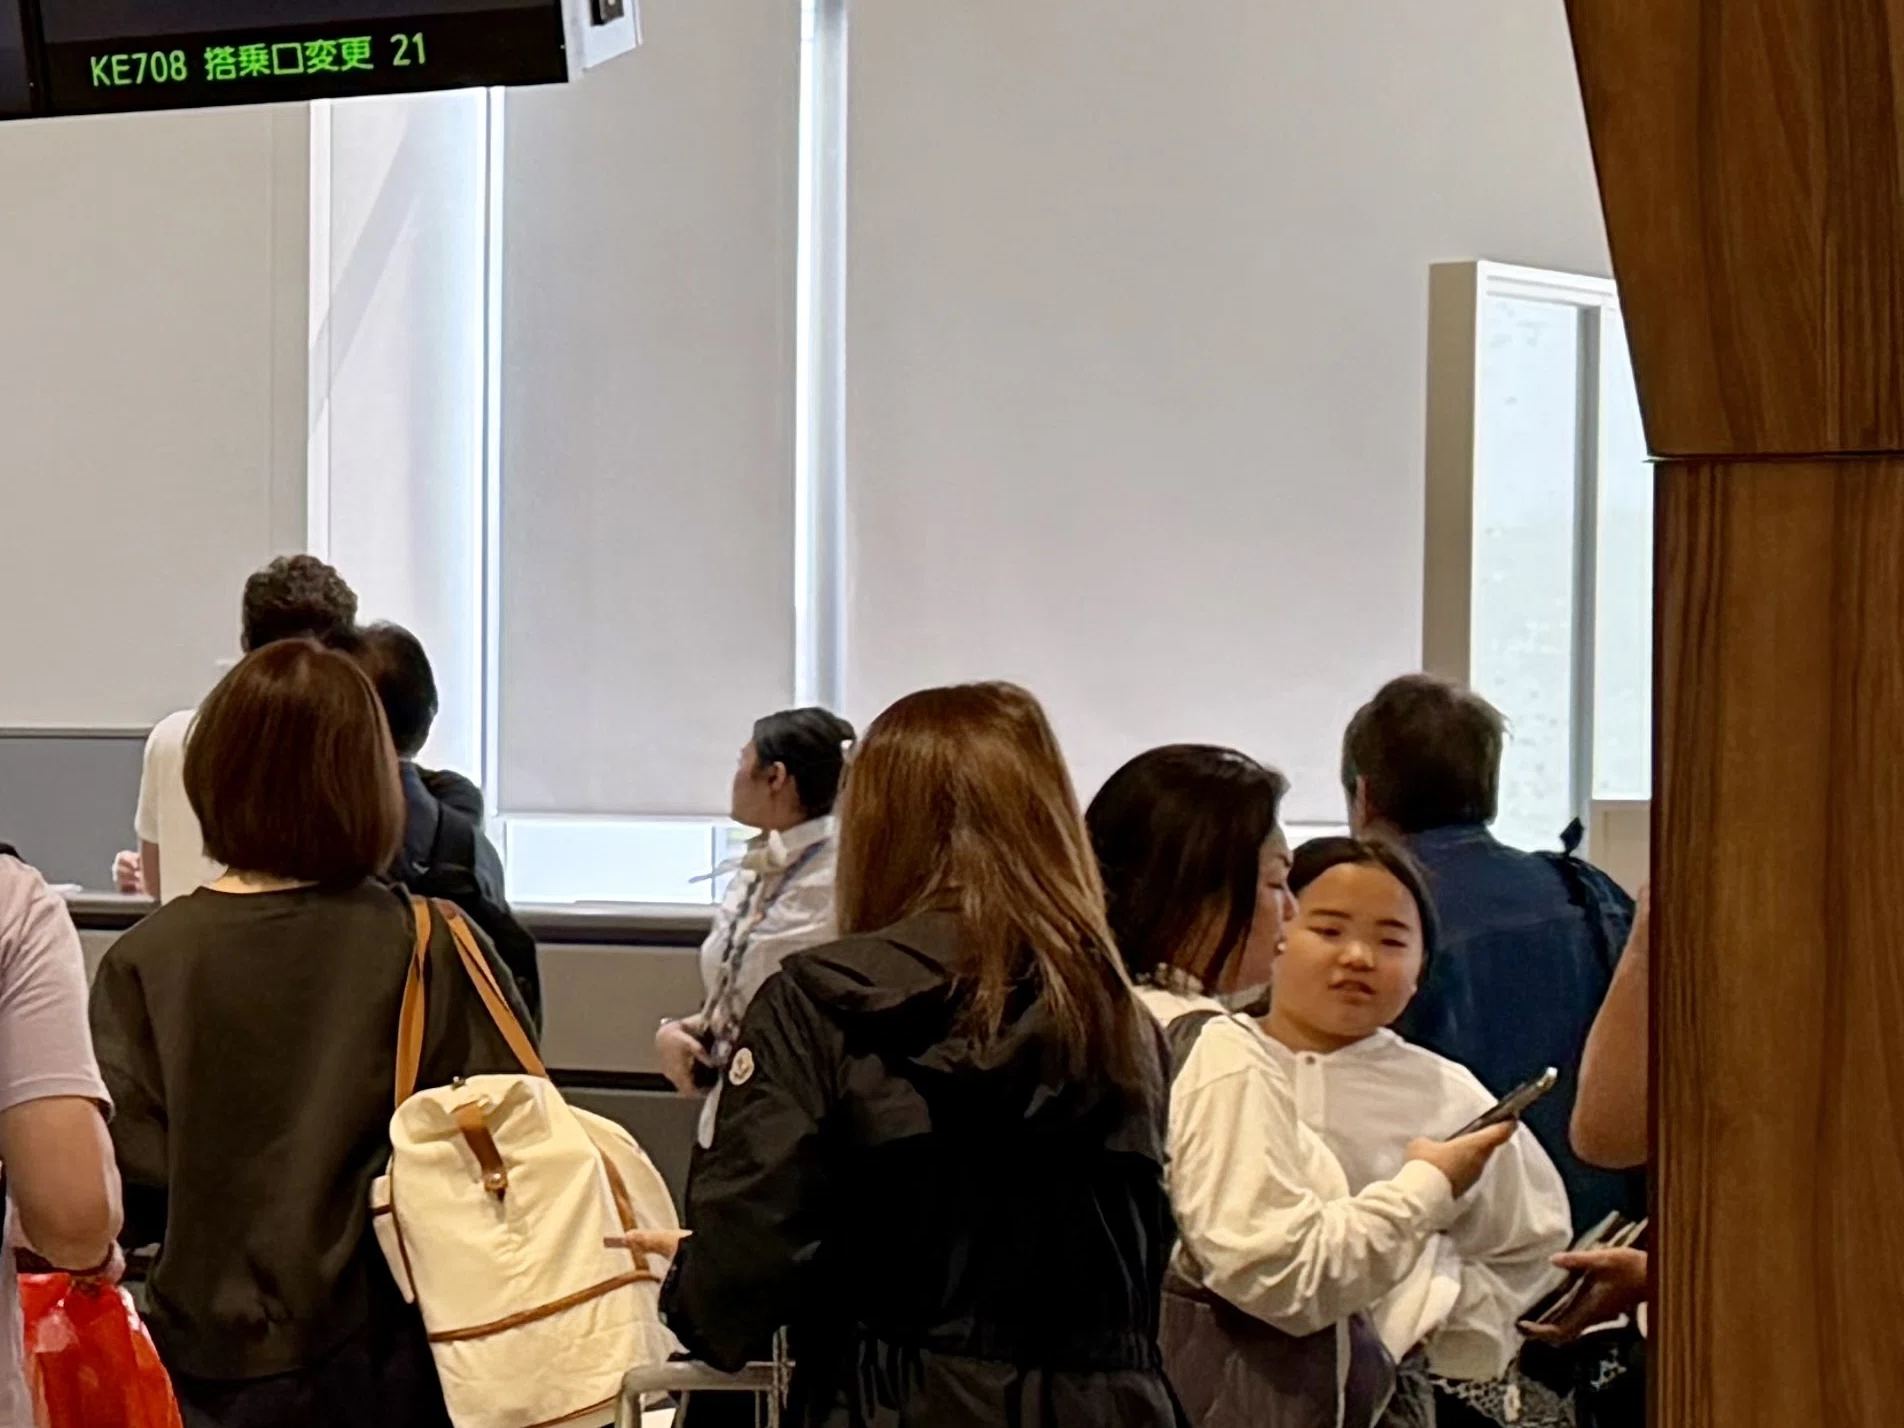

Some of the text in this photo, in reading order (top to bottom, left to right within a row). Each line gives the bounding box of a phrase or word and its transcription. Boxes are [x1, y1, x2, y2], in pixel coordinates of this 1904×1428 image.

[90, 31, 427, 88] KE708 搭乗口変更 21
